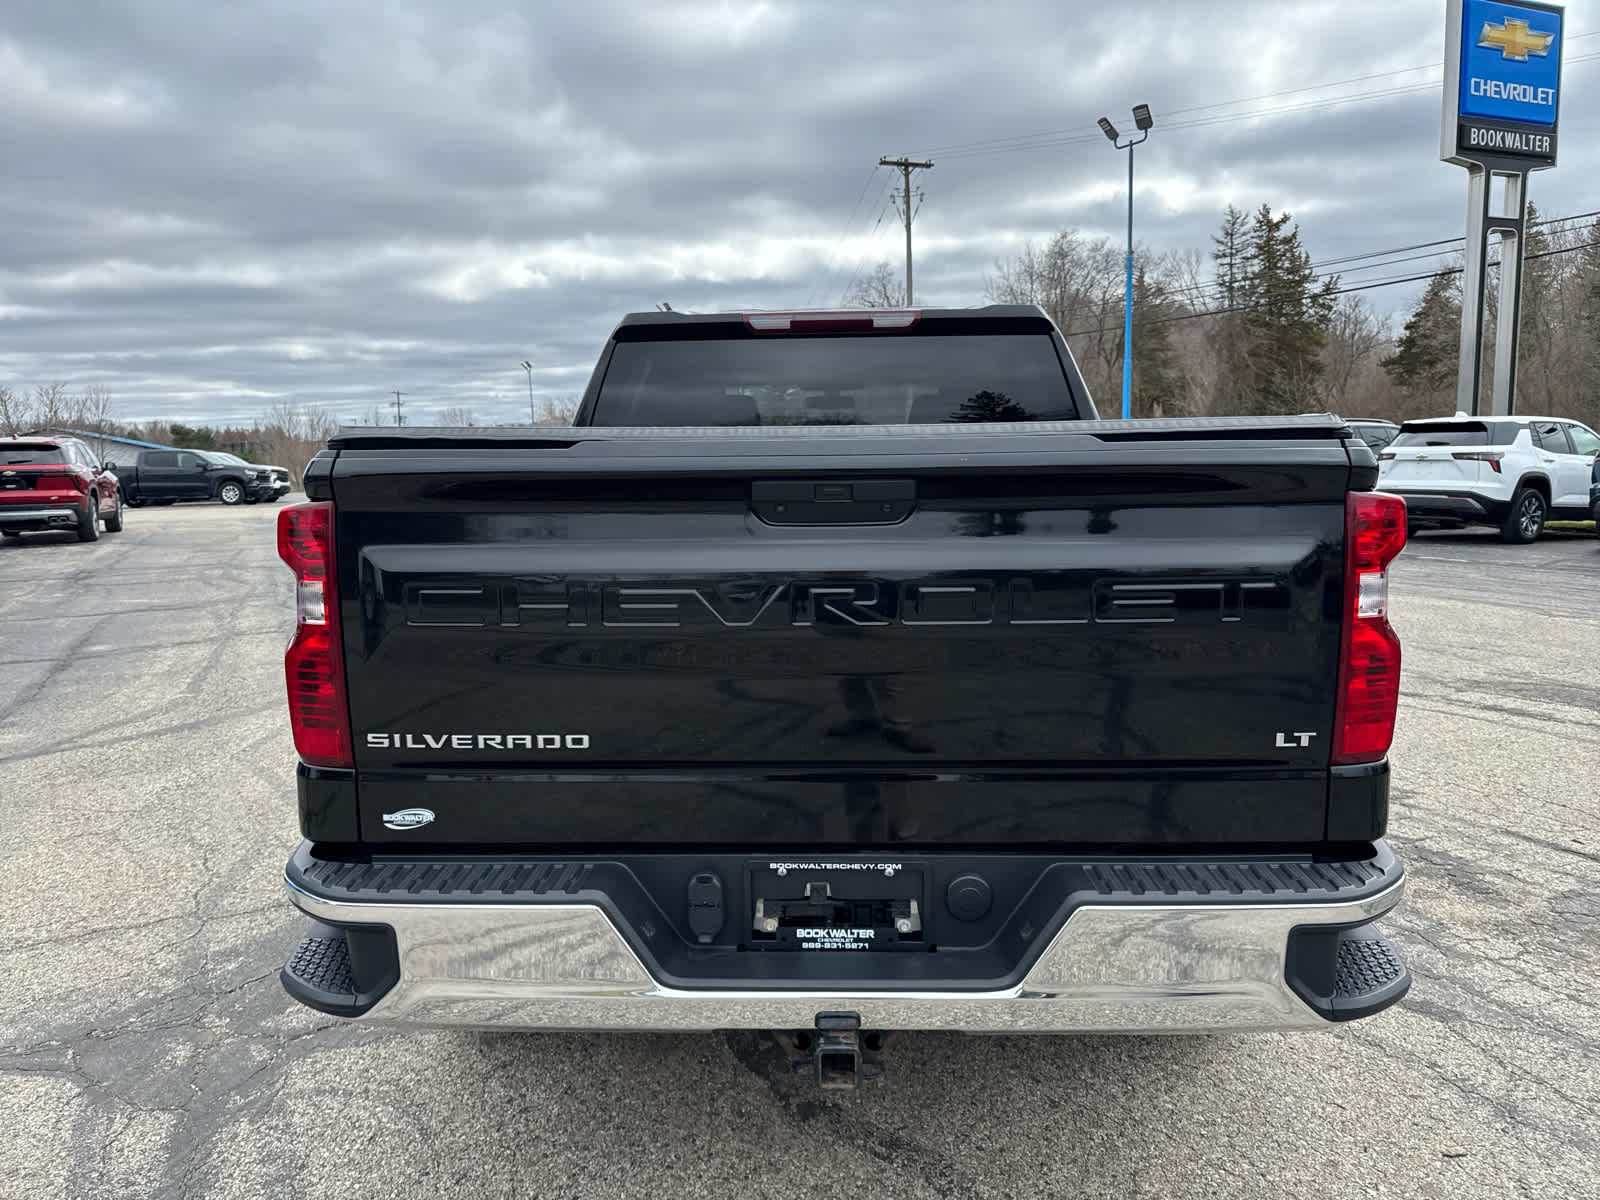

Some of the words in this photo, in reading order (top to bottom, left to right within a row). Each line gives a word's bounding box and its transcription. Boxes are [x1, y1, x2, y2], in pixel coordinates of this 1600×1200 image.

[1470, 77, 1555, 105] CHEVROLET
[1470, 128, 1550, 152] BOOKWALTER
[404, 580, 1278, 627] CHEVROLET
[366, 733, 590, 749] SILVERADO
[1275, 732, 1317, 747] LT
[769, 862, 902, 871] BOOKWALTERCHEVY.COM
[796, 928, 875, 939] BOOKWALTER
